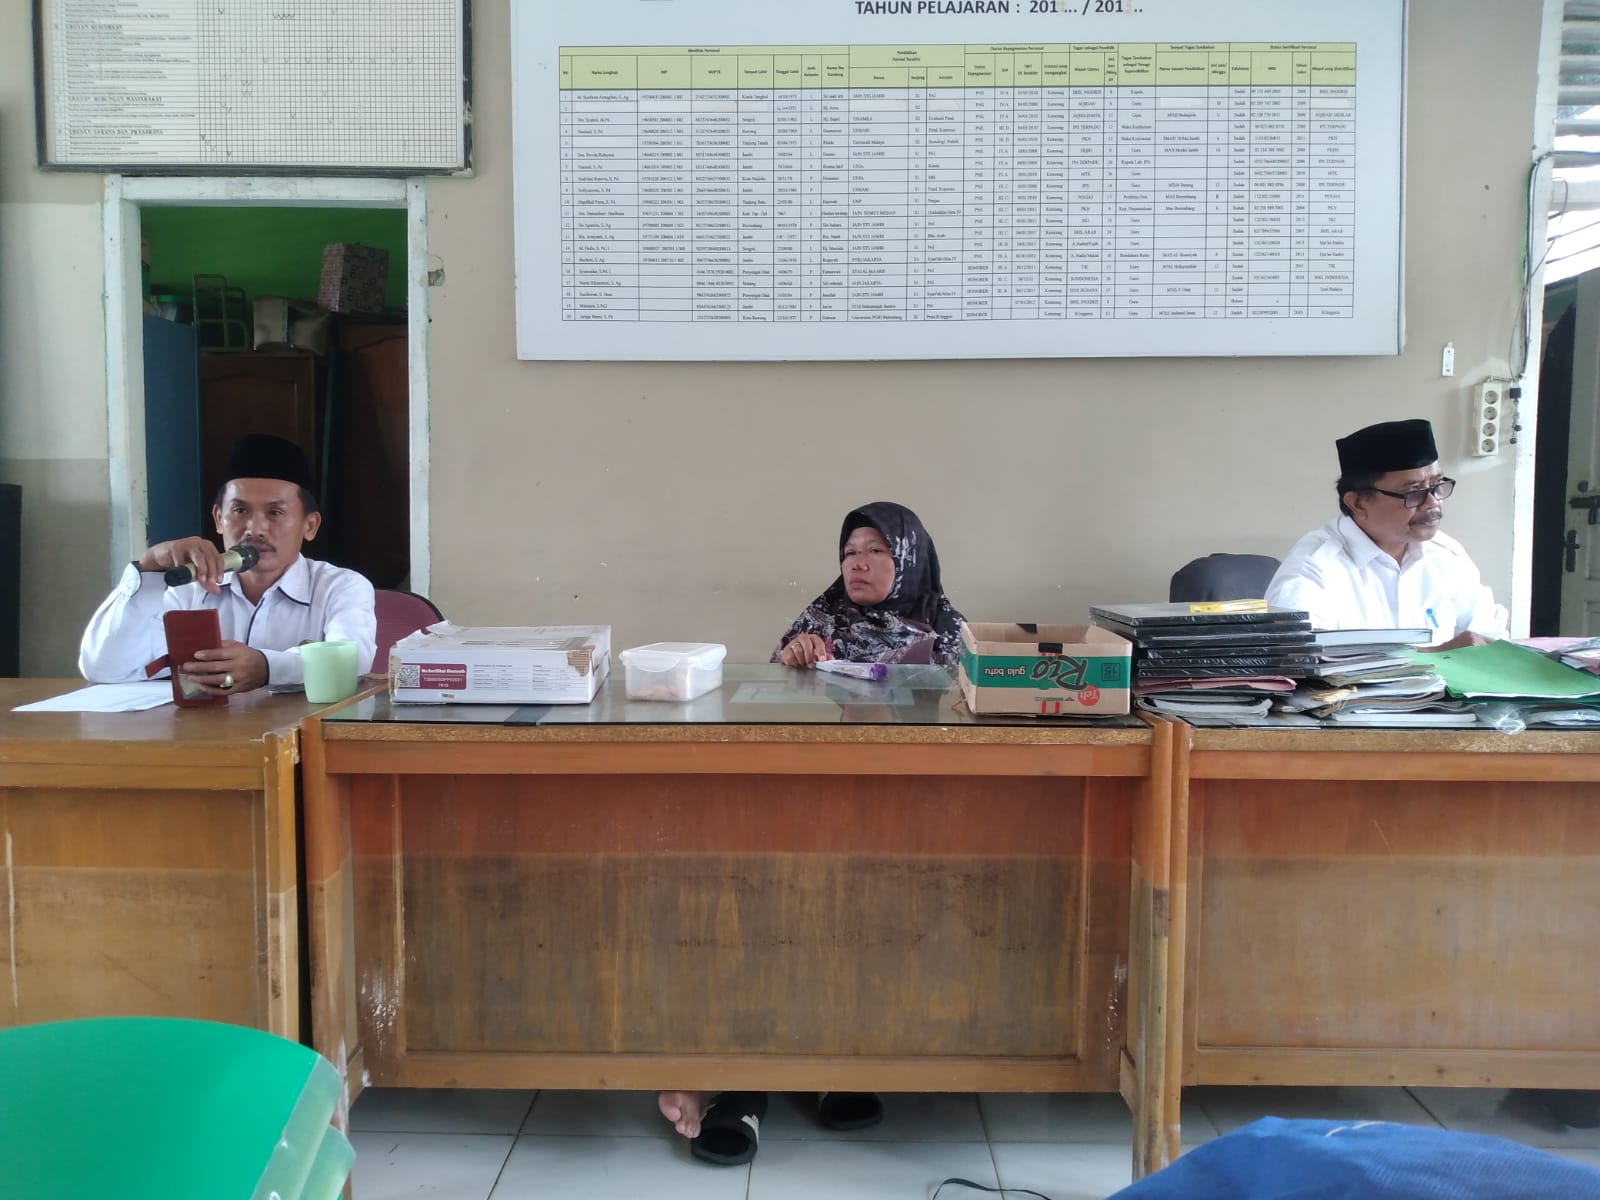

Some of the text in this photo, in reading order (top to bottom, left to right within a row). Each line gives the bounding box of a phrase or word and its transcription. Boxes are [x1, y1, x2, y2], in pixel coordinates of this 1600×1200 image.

[855, 1, 912, 14] TAHUN
[918, 1, 1009, 14] PELAJARAN
[984, 667, 1026, 677] gula batu
